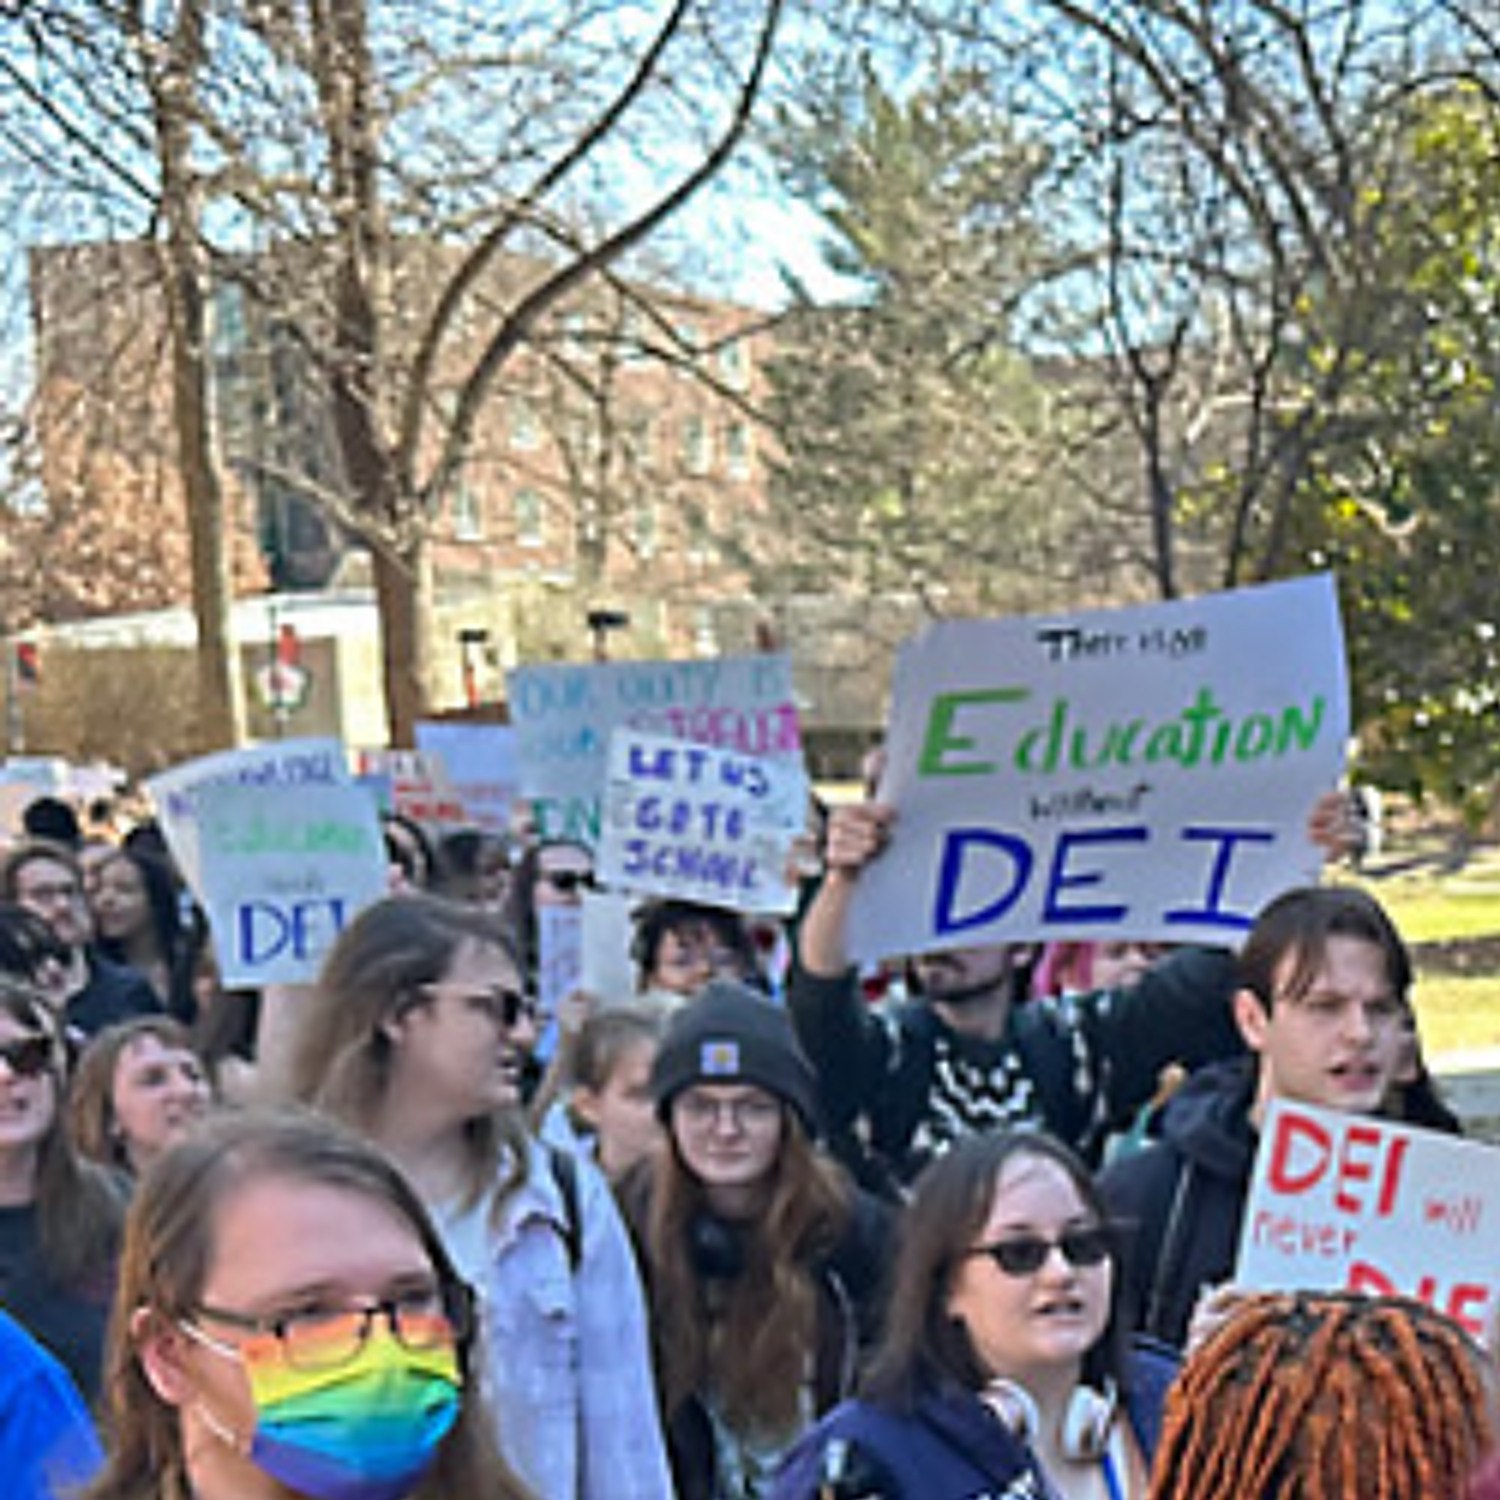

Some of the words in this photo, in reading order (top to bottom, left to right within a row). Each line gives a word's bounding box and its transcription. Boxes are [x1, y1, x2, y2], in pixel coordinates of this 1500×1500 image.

[628, 744, 710, 783] LET
[719, 758, 771, 798] US
[636, 797, 692, 836] GO
[700, 801, 744, 841] TO
[622, 839, 758, 889] SCHOOL
[934, 825, 1276, 938] DEI
[1268, 1111, 1411, 1218] DEI
[1252, 1209, 1359, 1257] never
